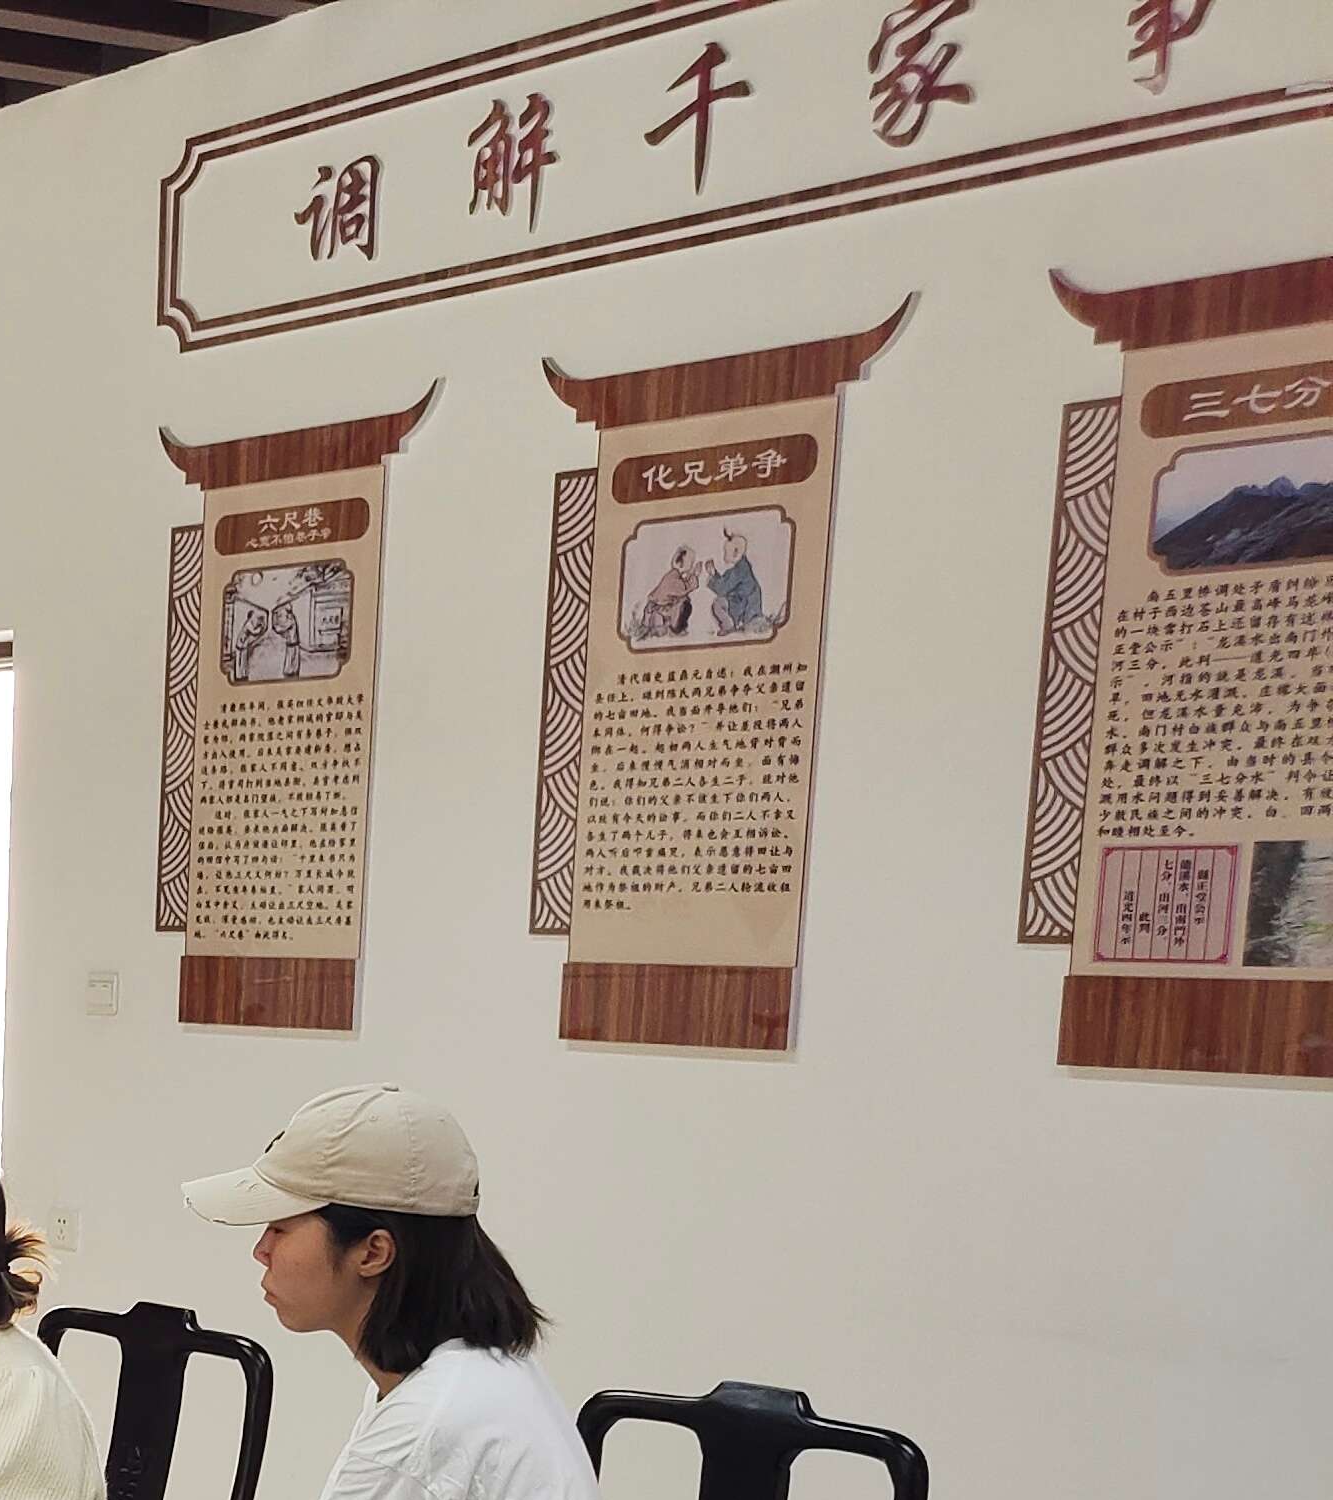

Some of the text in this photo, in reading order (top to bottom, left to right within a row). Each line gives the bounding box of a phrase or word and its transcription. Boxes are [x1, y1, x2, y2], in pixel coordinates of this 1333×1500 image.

[1182, 376, 1333, 422] 三七分
[642, 449, 788, 493] 化兄弟争
[258, 507, 324, 532] 六尺巷
